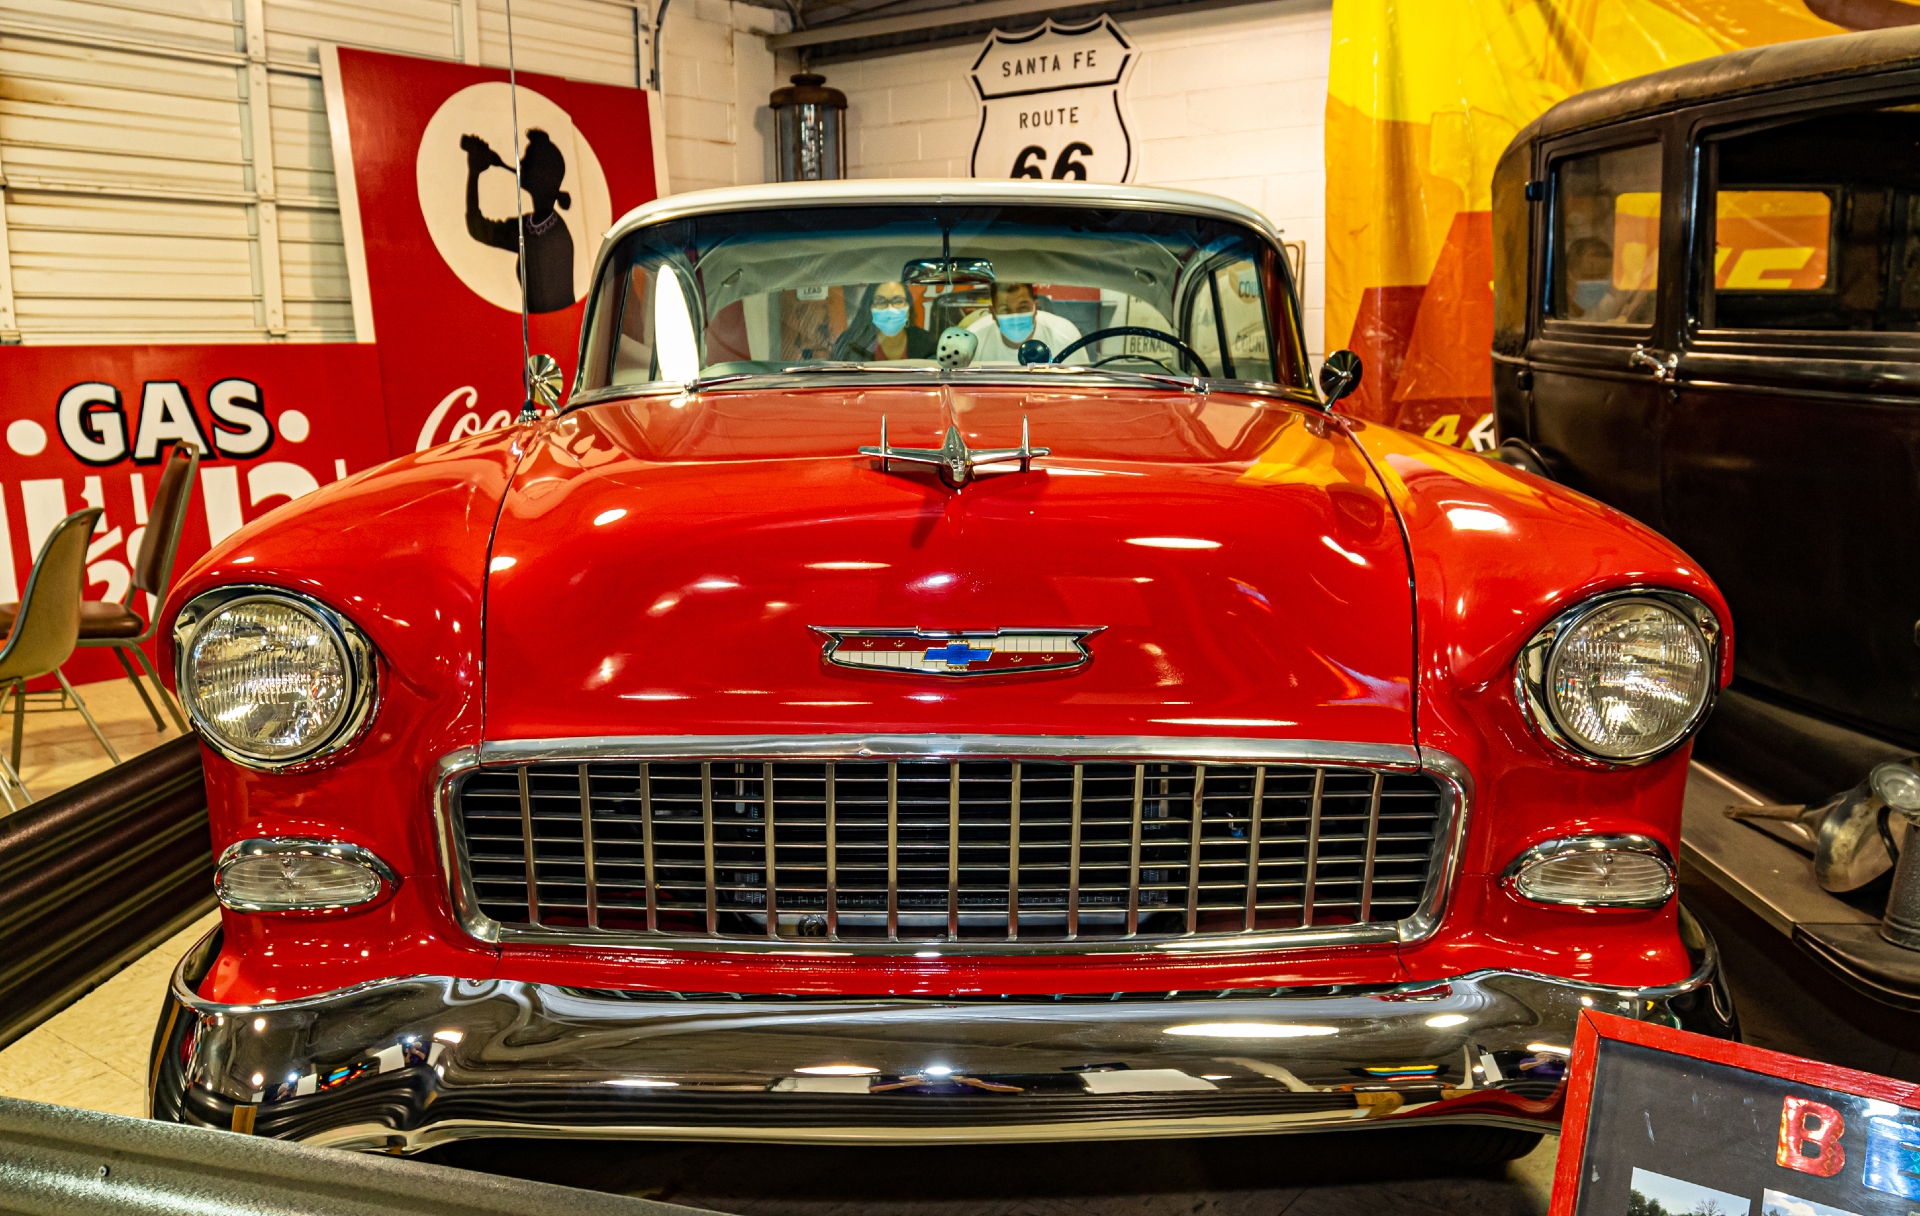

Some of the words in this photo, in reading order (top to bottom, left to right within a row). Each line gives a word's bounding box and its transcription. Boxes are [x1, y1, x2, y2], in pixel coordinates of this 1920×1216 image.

[1002, 54, 1060, 77] SANTA
[1073, 50, 1097, 69] FE
[1019, 107, 1079, 129] ROUTE
[1010, 141, 1094, 181] 66
[56, 377, 275, 467] GAS
